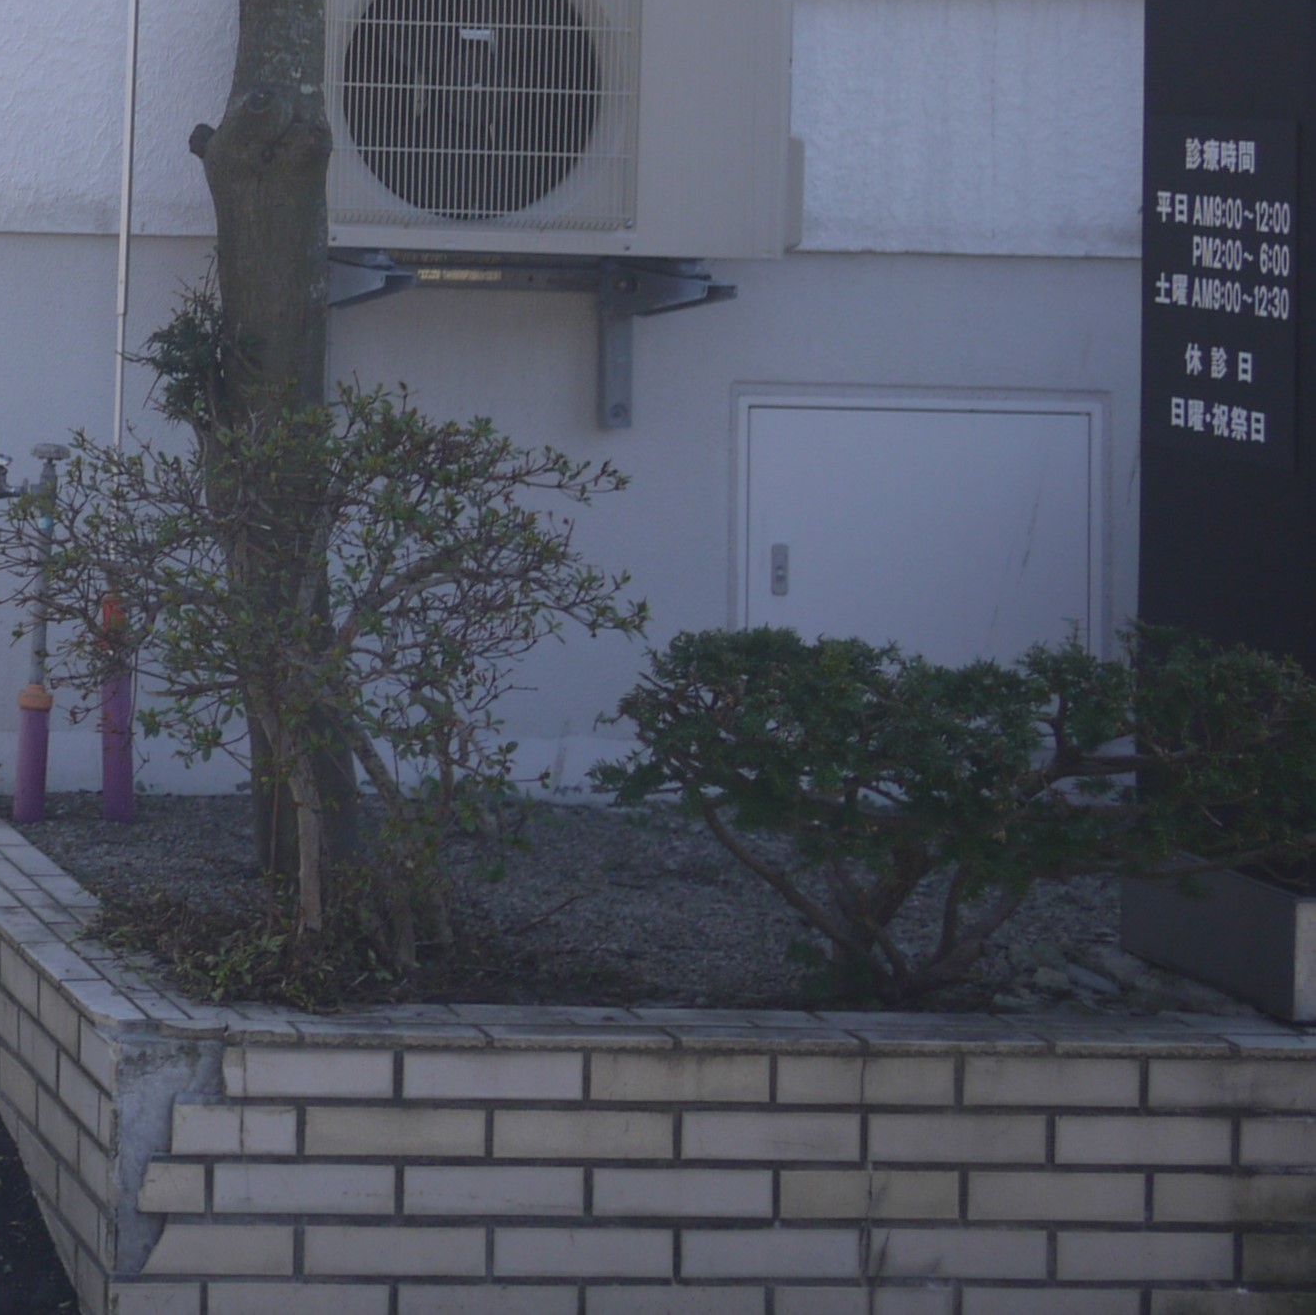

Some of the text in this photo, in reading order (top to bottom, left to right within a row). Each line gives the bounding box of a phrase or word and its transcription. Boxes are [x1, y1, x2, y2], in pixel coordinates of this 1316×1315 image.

[1185, 138, 1255, 174] 診療時間
[1156, 191, 1188, 223] 平日
[1155, 272, 1188, 306] 土曜
